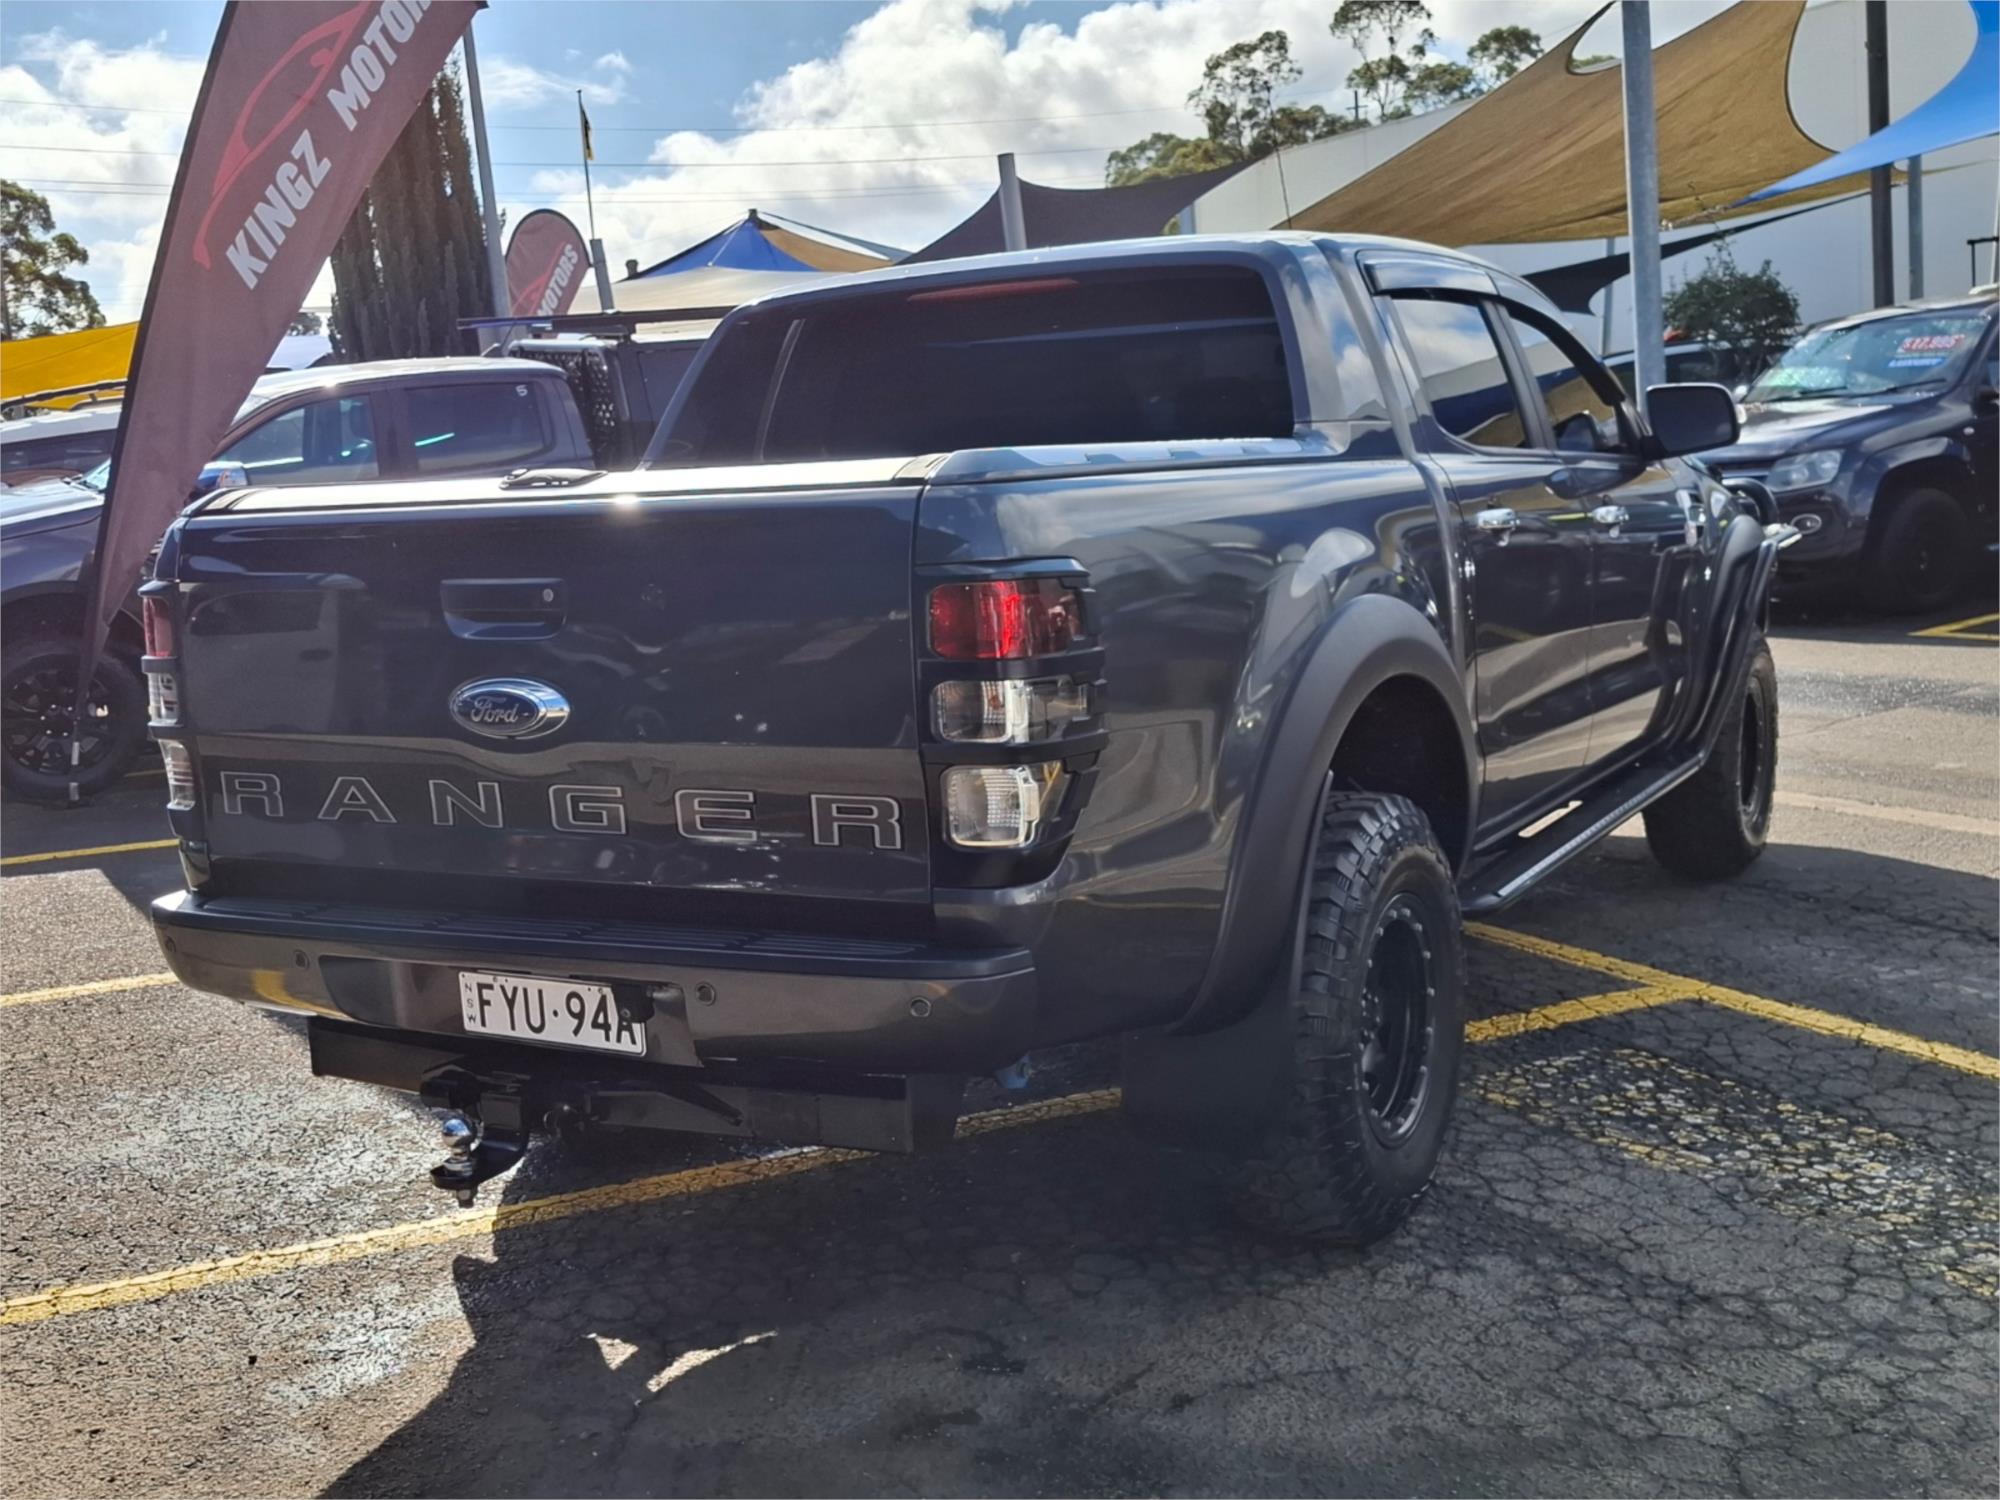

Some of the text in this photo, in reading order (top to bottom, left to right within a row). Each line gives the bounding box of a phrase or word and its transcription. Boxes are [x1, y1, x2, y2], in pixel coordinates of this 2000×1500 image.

[225, 128, 332, 290] KINGZ
[536, 244, 579, 317] MOTORS
[470, 695, 520, 723] Ford
[219, 771, 902, 850] RANGER
[464, 982, 477, 1024] NSW
